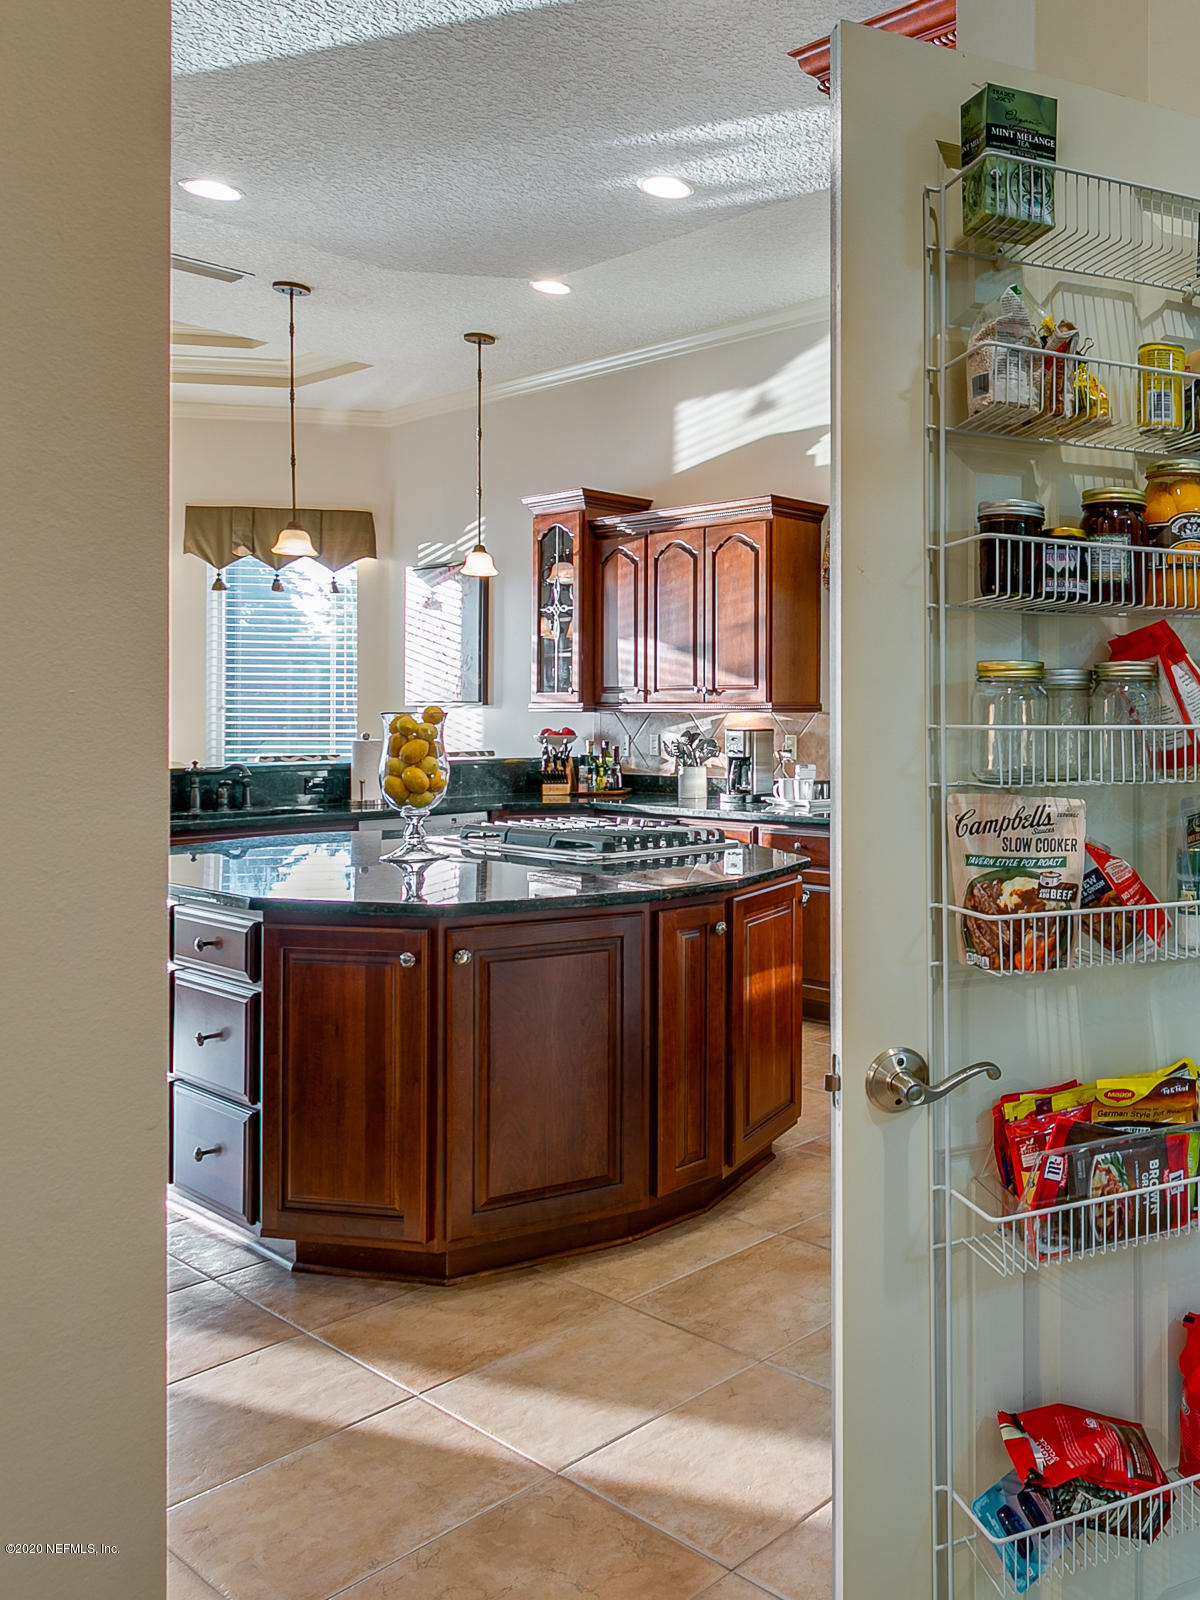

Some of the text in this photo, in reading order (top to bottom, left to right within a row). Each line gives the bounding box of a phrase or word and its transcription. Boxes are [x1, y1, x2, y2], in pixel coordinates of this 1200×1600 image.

[991, 126, 1055, 148] MINT MELANGE
[1017, 139, 1031, 148] TEA
[955, 804, 1055, 838] Campbell's
[1001, 836, 1078, 853] SLOW COOKER
[967, 856, 1063, 867] TAVERN STYLE POT ROAST
[1050, 888, 1073, 900] BEEF
[1097, 1109, 1128, 1118] German
[1130, 1110, 1151, 1119] Style
